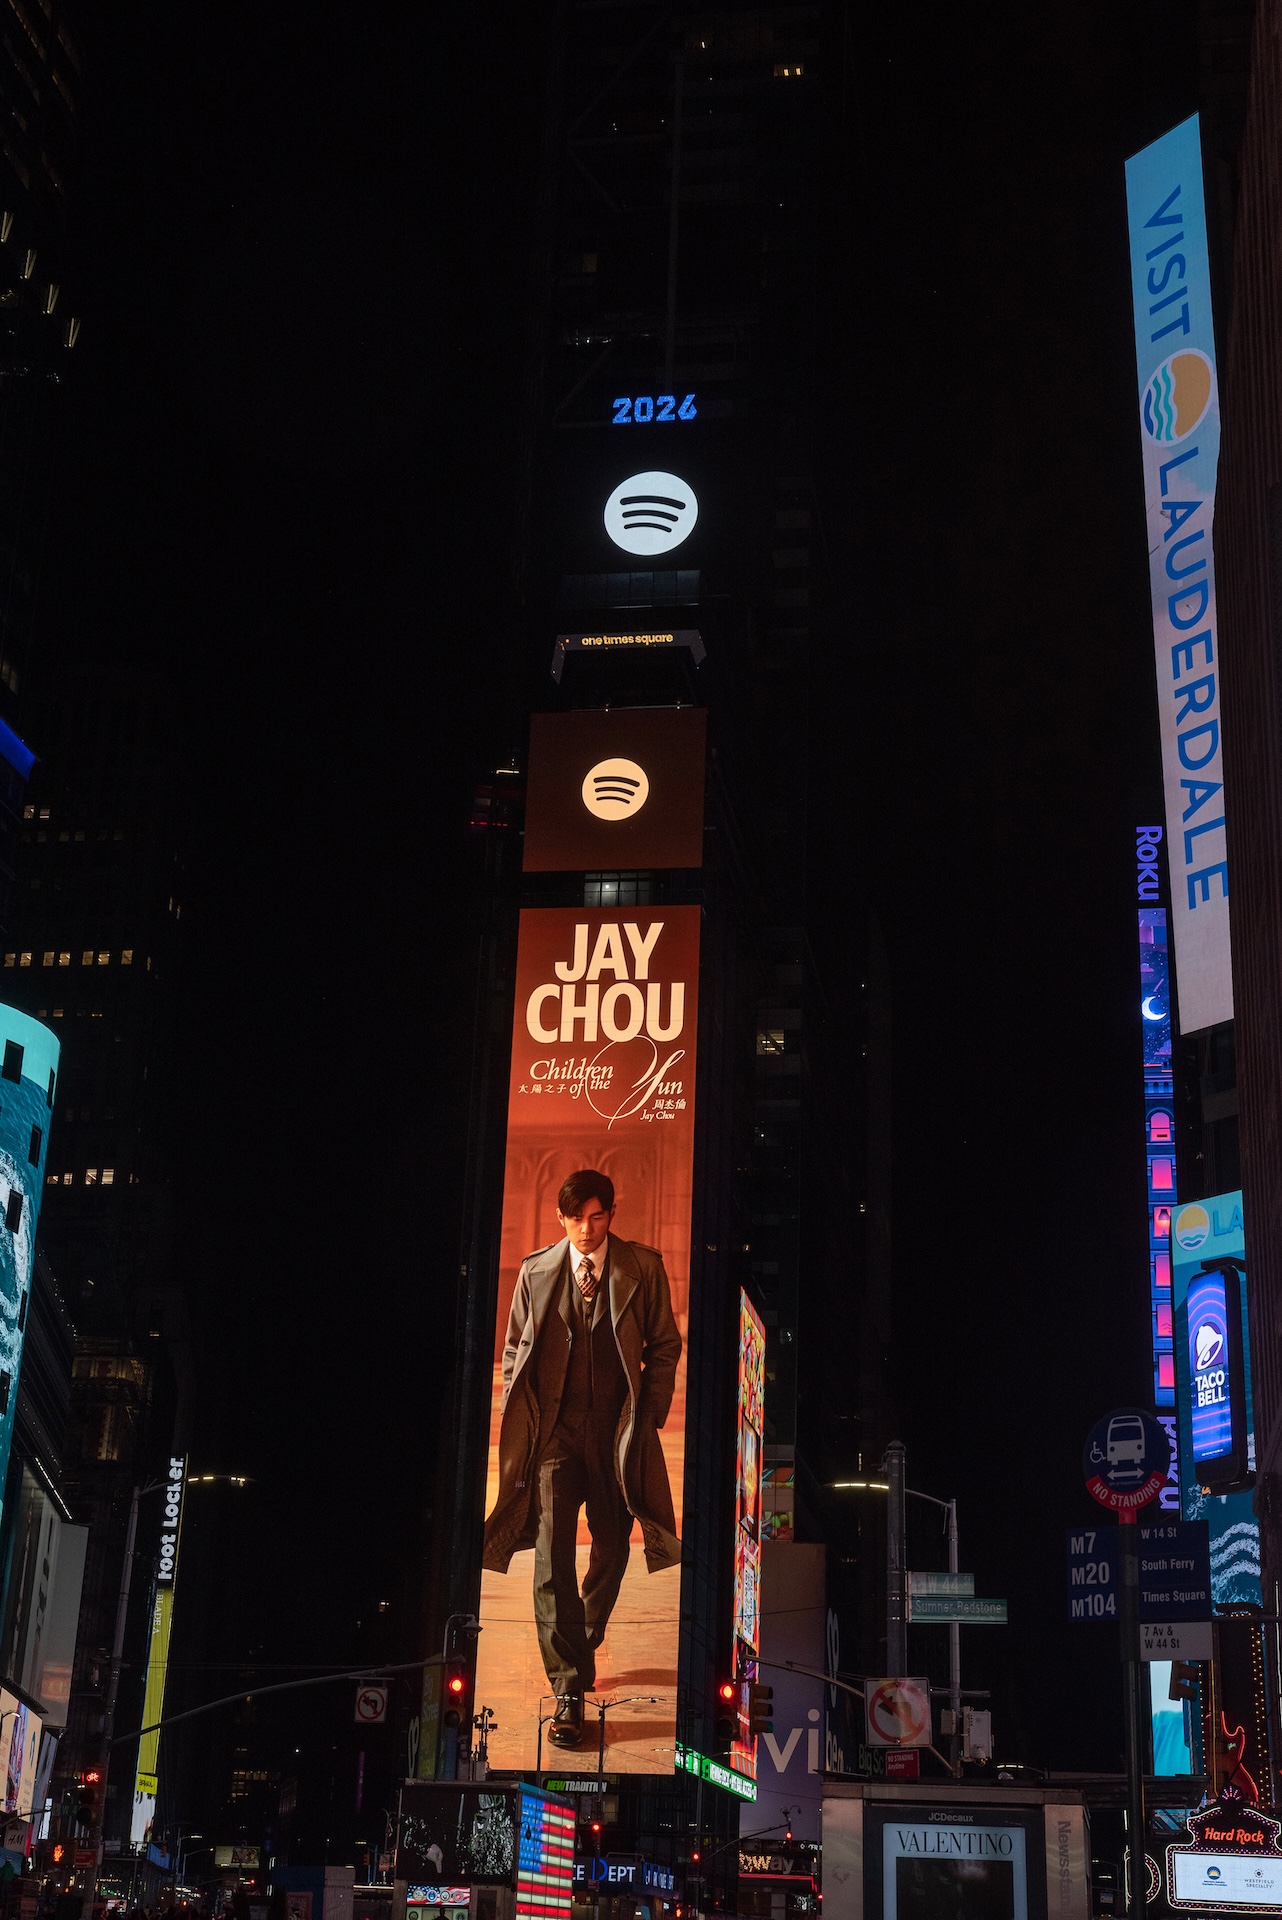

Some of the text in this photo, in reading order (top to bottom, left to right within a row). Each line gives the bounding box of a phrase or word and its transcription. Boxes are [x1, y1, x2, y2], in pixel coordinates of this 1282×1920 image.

[611, 393, 698, 424] 2026
[1143, 184, 1229, 910] VISIT LAUDERDALE
[581, 634, 673, 646] one times square
[554, 922, 665, 982] JAY
[526, 982, 685, 1043] CHOU
[529, 1057, 614, 1081] Children
[569, 1077, 586, 1099] of
[590, 1077, 611, 1090] the
[640, 1109, 675, 1122] Jay Chou
[1195, 1369, 1225, 1392] TACO
[1197, 1386, 1227, 1408] BELL
[1092, 1477, 1161, 1507] NO STANDING
[1070, 1531, 1097, 1555] M7
[1141, 1526, 1178, 1539] W 14 St
[1071, 1561, 1111, 1585] M20
[1141, 1558, 1196, 1572] South Ferry
[926, 1575, 937, 1595] W
[942, 1575, 960, 1595] 44
[915, 1600, 1002, 1614] Sumner Redstone
[1071, 1592, 1117, 1617] M104
[1142, 1589, 1206, 1604] Times Square
[1144, 1626, 1173, 1636] 7 Av &
[1144, 1638, 1180, 1649] W 44 St
[928, 1812, 973, 1822] JCDecaux
[896, 1830, 1013, 1856] VALENTINO
[1204, 1827, 1265, 1845] Hard Rock
